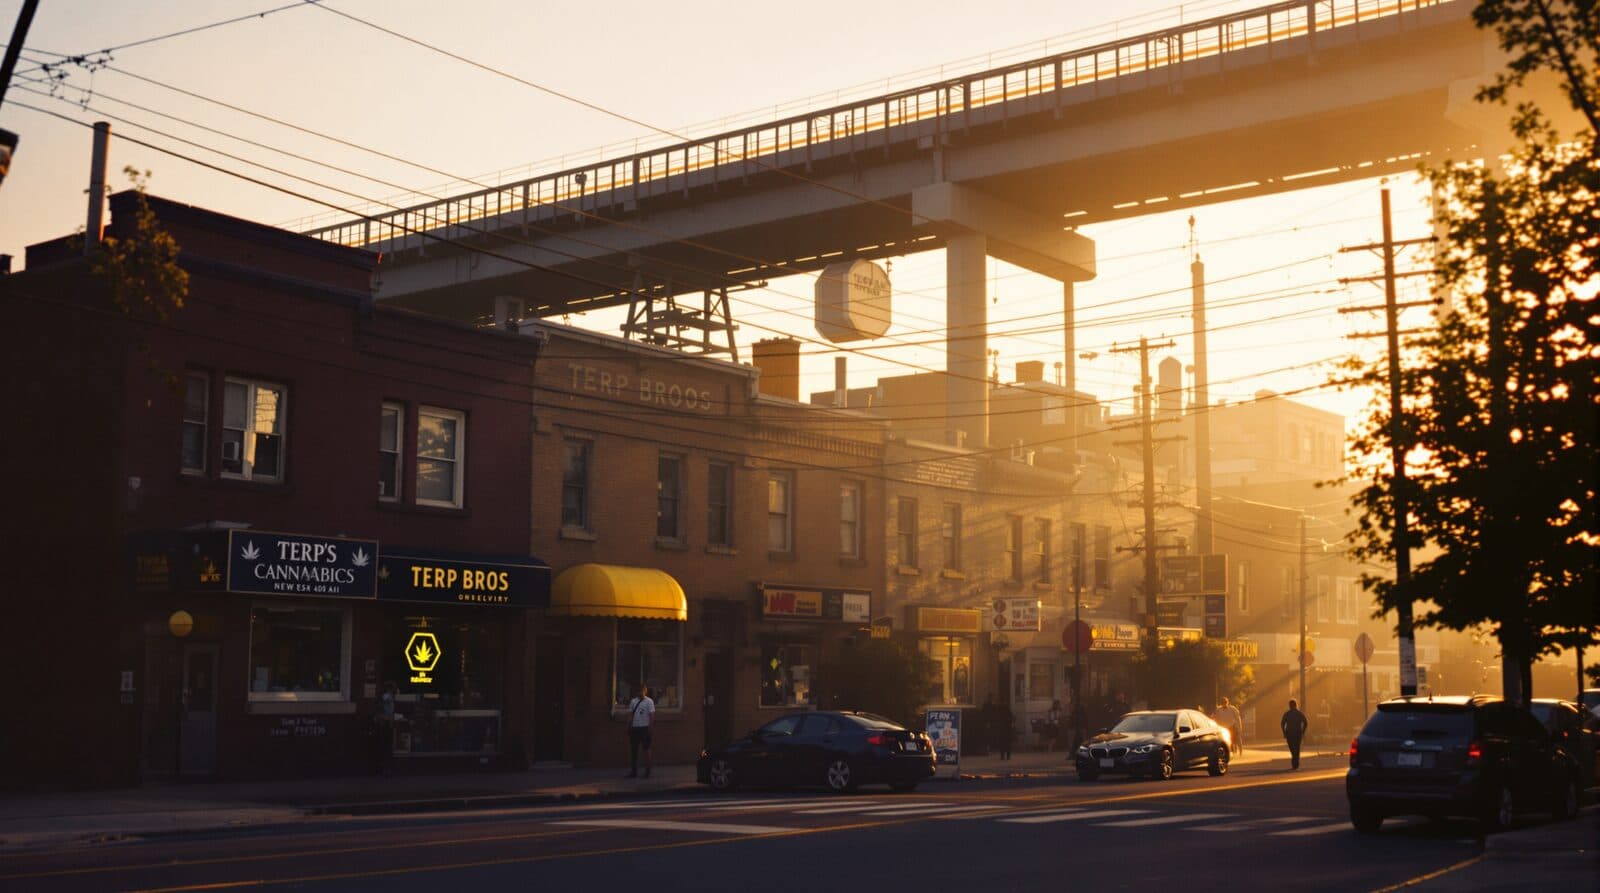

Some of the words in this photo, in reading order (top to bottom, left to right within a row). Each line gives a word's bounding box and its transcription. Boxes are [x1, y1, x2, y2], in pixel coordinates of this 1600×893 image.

[568, 362, 628, 397] TERP
[640, 377, 712, 410] BROOS
[277, 541, 337, 563] TERP'S
[411, 566, 457, 588] TERP
[463, 569, 509, 591] BROS
